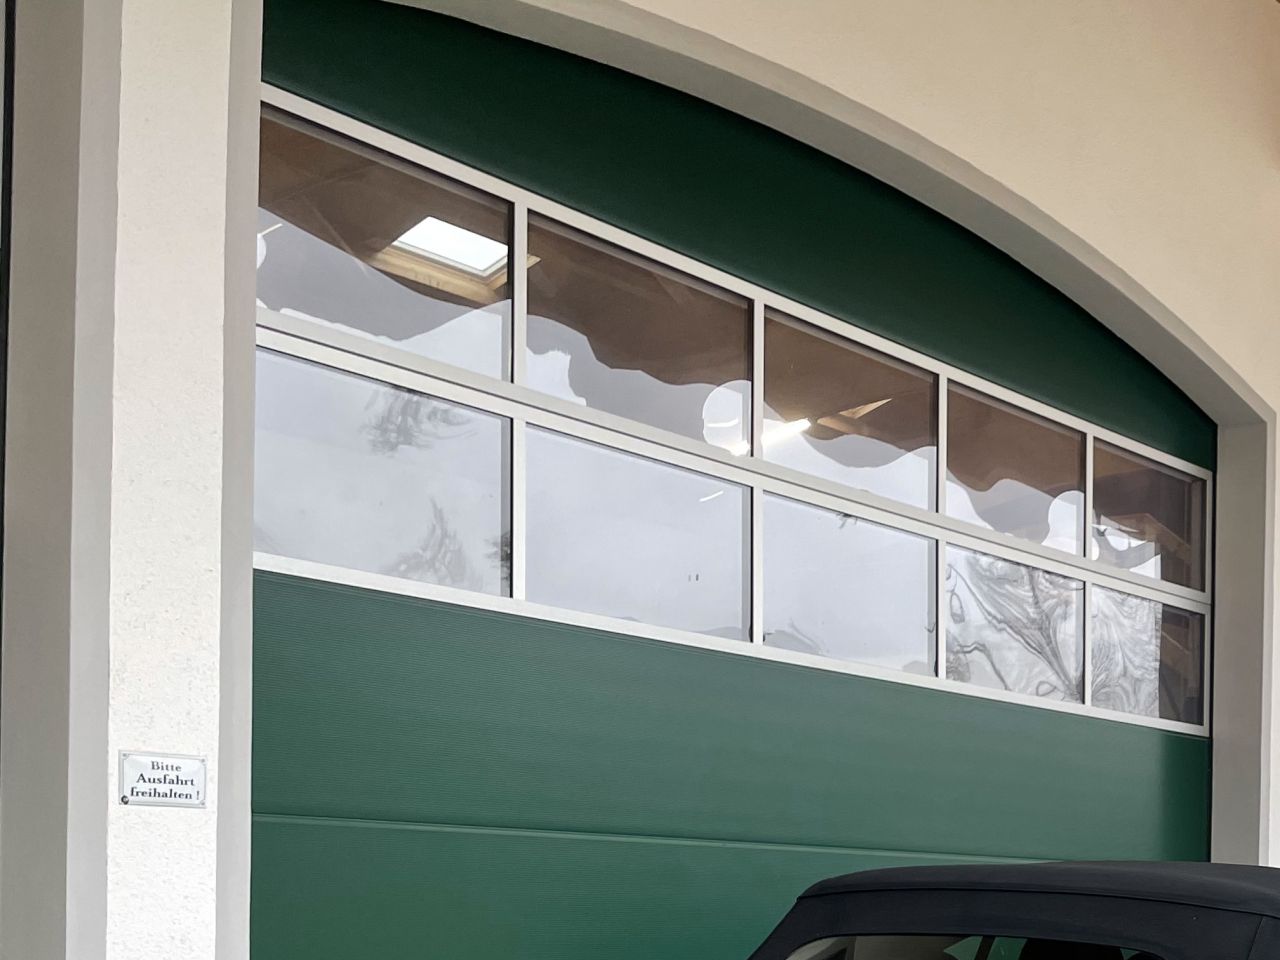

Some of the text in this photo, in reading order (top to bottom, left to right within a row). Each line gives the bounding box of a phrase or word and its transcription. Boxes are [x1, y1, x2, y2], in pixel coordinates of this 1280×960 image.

[151, 760, 182, 772] Bitte
[136, 773, 195, 786] Ausfahrt
[130, 786, 193, 800] freihalten
